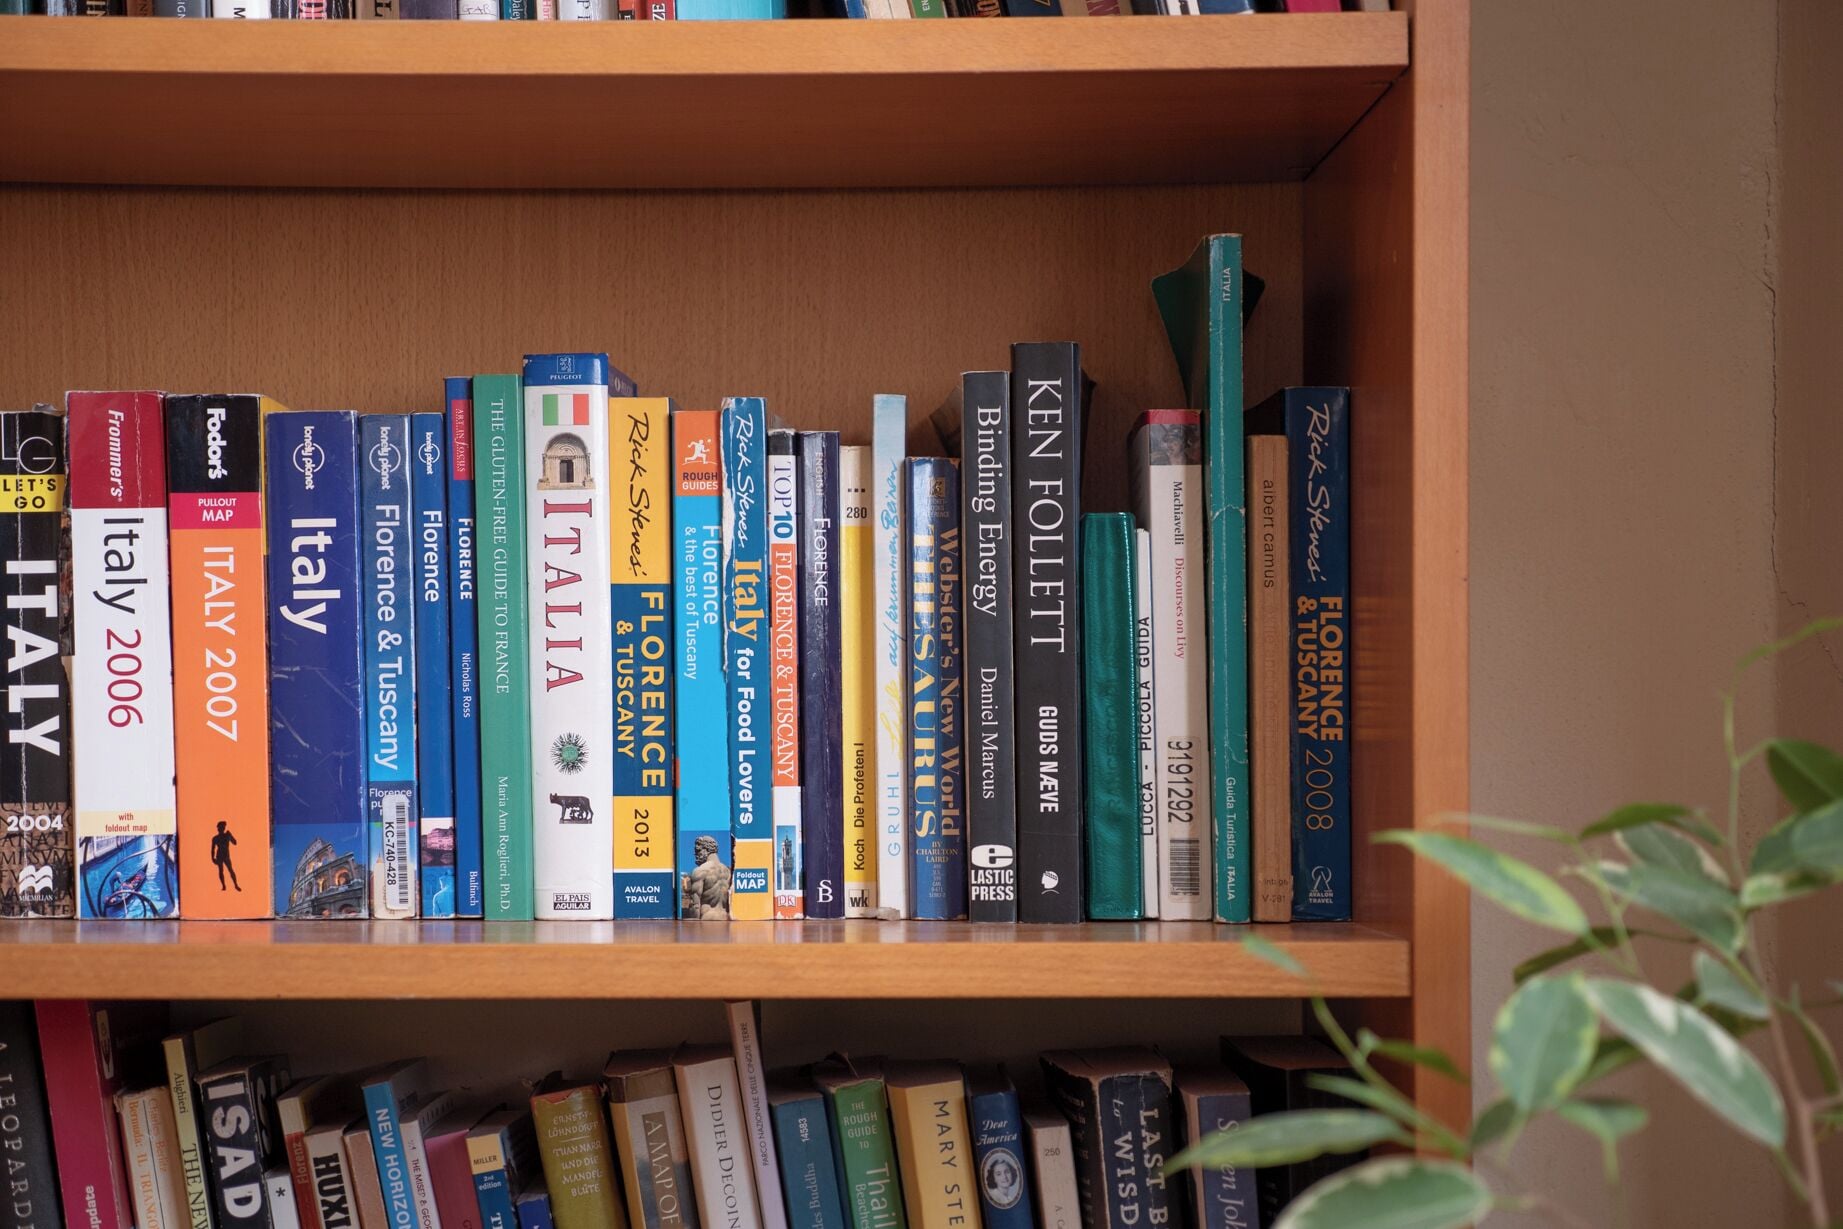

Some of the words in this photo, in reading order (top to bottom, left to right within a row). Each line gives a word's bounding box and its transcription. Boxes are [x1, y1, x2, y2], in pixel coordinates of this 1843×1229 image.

[1222, 268, 1231, 302] ITALIA
[491, 399, 504, 428] THE
[1027, 377, 1063, 459] KEN
[107, 409, 124, 499] Frommer's
[206, 407, 228, 480] Fodor's
[303, 426, 315, 461] lonely
[379, 426, 391, 461] lonely
[424, 431, 434, 457] lonely
[627, 411, 650, 484] Rick
[735, 413, 754, 472] Rick
[972, 405, 1003, 513] Binding
[1306, 403, 1330, 475] Rick
[2, 478, 57, 492] LET'S
[303, 463, 315, 490] planet
[381, 463, 391, 490] planet
[425, 457, 434, 475] planet
[682, 472, 718, 481] ROUGH
[682, 481, 719, 490] GUIDES
[815, 451, 824, 496] ENGLISH
[14, 496, 46, 509] GO
[198, 497, 237, 508] PULLOUT
[492, 434, 507, 544] GLUTEN-FREE
[1263, 479, 1275, 529] albert
[201, 510, 234, 522] MAP
[685, 527, 697, 537] &
[846, 506, 868, 519] 280
[1173, 480, 1186, 546] Machiavelli
[93, 518, 148, 615] Italy
[375, 504, 400, 622] Florence
[422, 510, 443, 602] Florence
[458, 518, 474, 600] FLORENCE
[685, 539, 698, 562] the
[813, 517, 831, 606] FLORENCE
[973, 521, 1003, 617] Energy
[1029, 478, 1065, 653] FOLLETT
[1263, 532, 1275, 589] camus
[203, 546, 236, 636] ITALY
[280, 518, 342, 635] Italy
[492, 549, 507, 597] GUIDE
[686, 567, 698, 598] best
[702, 525, 722, 625] Florence
[1174, 557, 1186, 618] Discourses
[494, 603, 509, 625] TO
[543, 498, 593, 693] ITALIA
[686, 603, 699, 616] of
[729, 559, 765, 642] Italy
[775, 551, 793, 660] FLORENCE
[939, 527, 960, 668] Webster's
[1297, 595, 1317, 615] &
[378, 630, 403, 652] &
[616, 620, 634, 635] &
[1136, 616, 1150, 668] GUIDA
[1174, 636, 1187, 660] Livy
[1176, 619, 1184, 634] on
[5, 560, 61, 757] ITALY
[495, 631, 510, 694] FRANCE
[684, 619, 699, 680] Tuscany
[736, 647, 754, 680] for
[1319, 596, 1344, 742] FLORENCE
[106, 628, 144, 728] 2006
[462, 652, 470, 693] Nicholas
[641, 591, 665, 788] FLORENCE
[776, 665, 793, 680] &
[912, 523, 937, 838] THESAURUS
[1297, 619, 1319, 740] TUSCANY
[205, 648, 238, 742] 2007
[374, 657, 403, 771] Tuscany
[462, 695, 471, 718] Ross
[616, 644, 635, 758] TUSCANY
[737, 687, 756, 742] Food
[940, 678, 960, 737] New
[980, 666, 999, 727] Daniel
[1138, 680, 1152, 752] PICCOLA
[776, 684, 794, 780] TUSCANY
[1038, 706, 1059, 755] GUDS
[853, 748, 865, 806] Profeten
[981, 732, 999, 799] Marcus
[1039, 761, 1059, 813] NÆVE
[497, 776, 509, 805] Maria
[738, 750, 756, 825] Lovers
[940, 746, 960, 837] World
[1140, 781, 1154, 837] LUCCA
[1226, 776, 1236, 809] Guida
[1305, 749, 1334, 831] 2008
[6, 815, 64, 832] 2004
[105, 823, 130, 833] foldout
[132, 825, 148, 833] map
[118, 812, 134, 822] with
[498, 808, 509, 830] Ann
[634, 809, 650, 858] 2013
[854, 810, 865, 828] Die
[887, 771, 901, 857] GRUHL
[384, 821, 397, 886] KC-740-428
[497, 835, 510, 880] Roglieri,
[853, 838, 865, 871] Koch
[916, 848, 958, 856] CHARLTON
[1226, 813, 1236, 860] Turistica
[469, 871, 478, 906] Bulfinch
[500, 883, 511, 912] Ph.D.
[555, 894, 564, 902] EL
[566, 894, 590, 902] PAIS
[624, 885, 661, 894] AVALON
[736, 879, 766, 890] MAP
[971, 869, 1014, 885] LASTIC
[971, 885, 1014, 901] PRESS
[1227, 866, 1236, 901] ITALIA
[554, 902, 591, 911] AGUILAR
[626, 895, 660, 903] TRAVEL
[778, 896, 796, 906] DK
[849, 893, 869, 908] wk
[740, 1023, 750, 1044] TERRE
[744, 1046, 755, 1074] CINQUE
[173, 1072, 188, 1115] Alighieri
[749, 1074, 759, 1095] DELLE
[850, 1101, 865, 1111] THE
[128, 1101, 144, 1148] Bermuda:
[375, 1108, 396, 1148] NEW
[645, 1119, 663, 1136] A
[707, 1084, 728, 1153] DIDIER
[753, 1096, 767, 1139] NAZIONALE
[798, 1117, 810, 1143] 14583
[843, 1112, 878, 1126] ROUGH
[847, 1125, 878, 1139] GUIDE
[933, 1100, 957, 1168] MARY
[976, 1131, 1017, 1146] America
[981, 1119, 1008, 1132] Dear
[182, 1143, 201, 1186] THE
[207, 1081, 262, 1219] ISAD
[411, 1158, 420, 1173] THE
[473, 1155, 497, 1165] MILLER
[649, 1142, 673, 1190] MAP
[759, 1140, 769, 1167] PARCO
[859, 1140, 870, 1150] TO
[1044, 1147, 1061, 1157] 250
[1139, 1108, 1166, 1190] LAST
[478, 1182, 502, 1191] edition
[803, 1162, 820, 1210] Buddha
[1113, 1131, 1140, 1225] WISD
[658, 1194, 681, 1225] OF
[944, 1183, 965, 1226] STE
[1149, 1206, 1170, 1226] B
